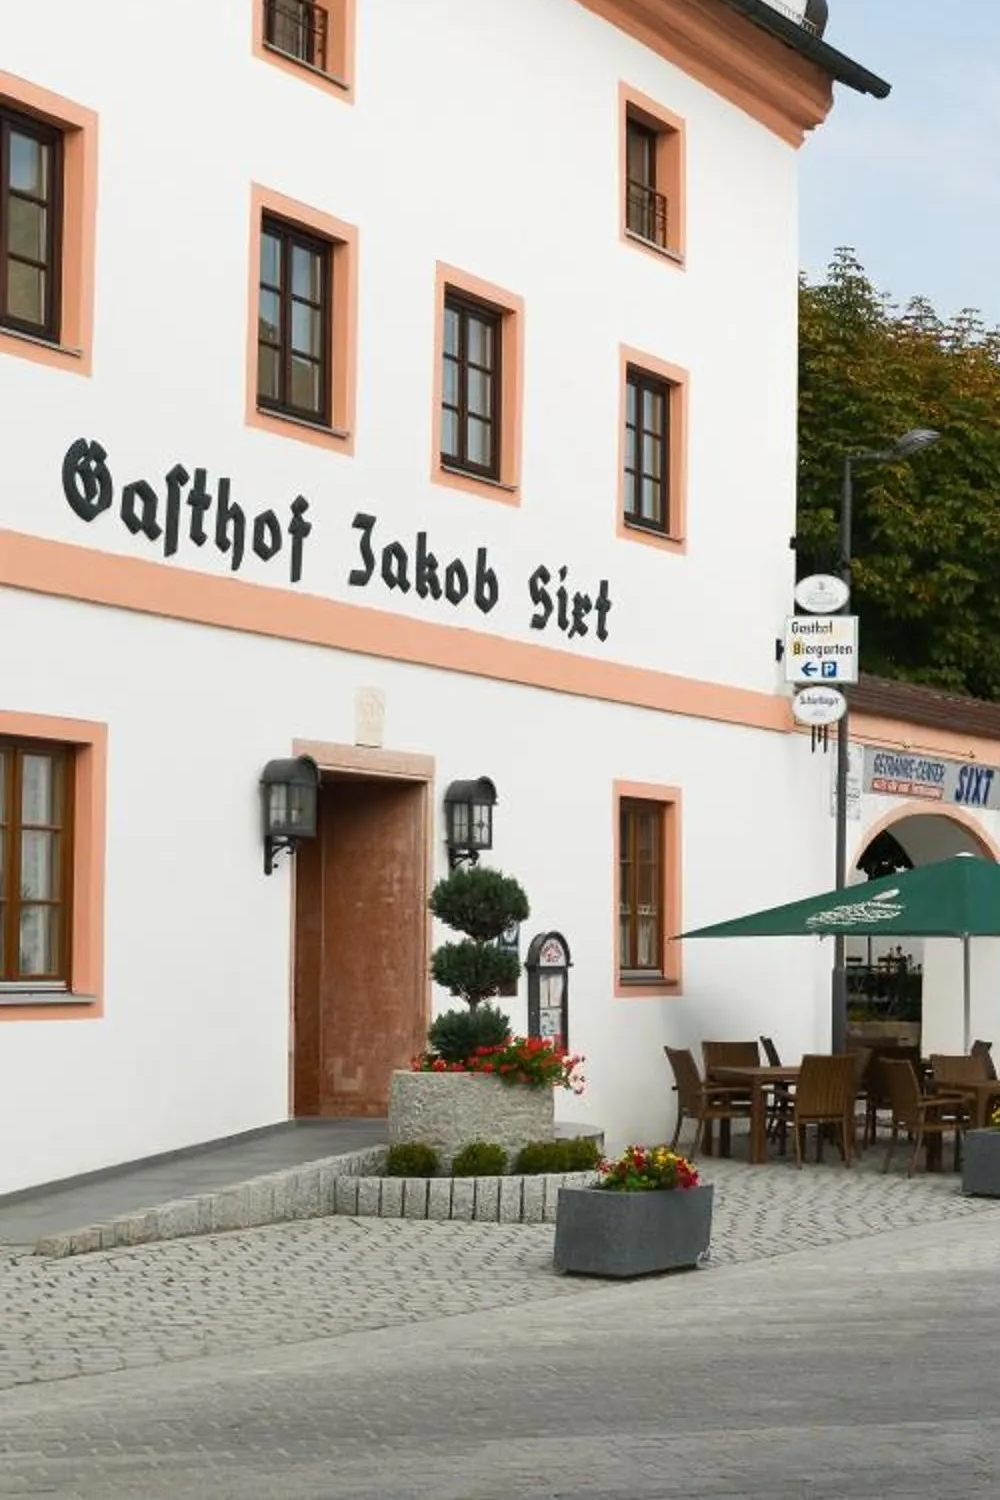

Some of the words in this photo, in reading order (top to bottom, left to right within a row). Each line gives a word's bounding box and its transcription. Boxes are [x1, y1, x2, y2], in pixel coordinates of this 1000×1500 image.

[61, 436, 312, 583] Gasthof
[348, 512, 501, 615] Jakob
[528, 563, 613, 643] Sixt
[791, 620, 833, 635] Gasthof
[793, 642, 853, 658] Biergarten
[955, 764, 995, 806] SIXT
